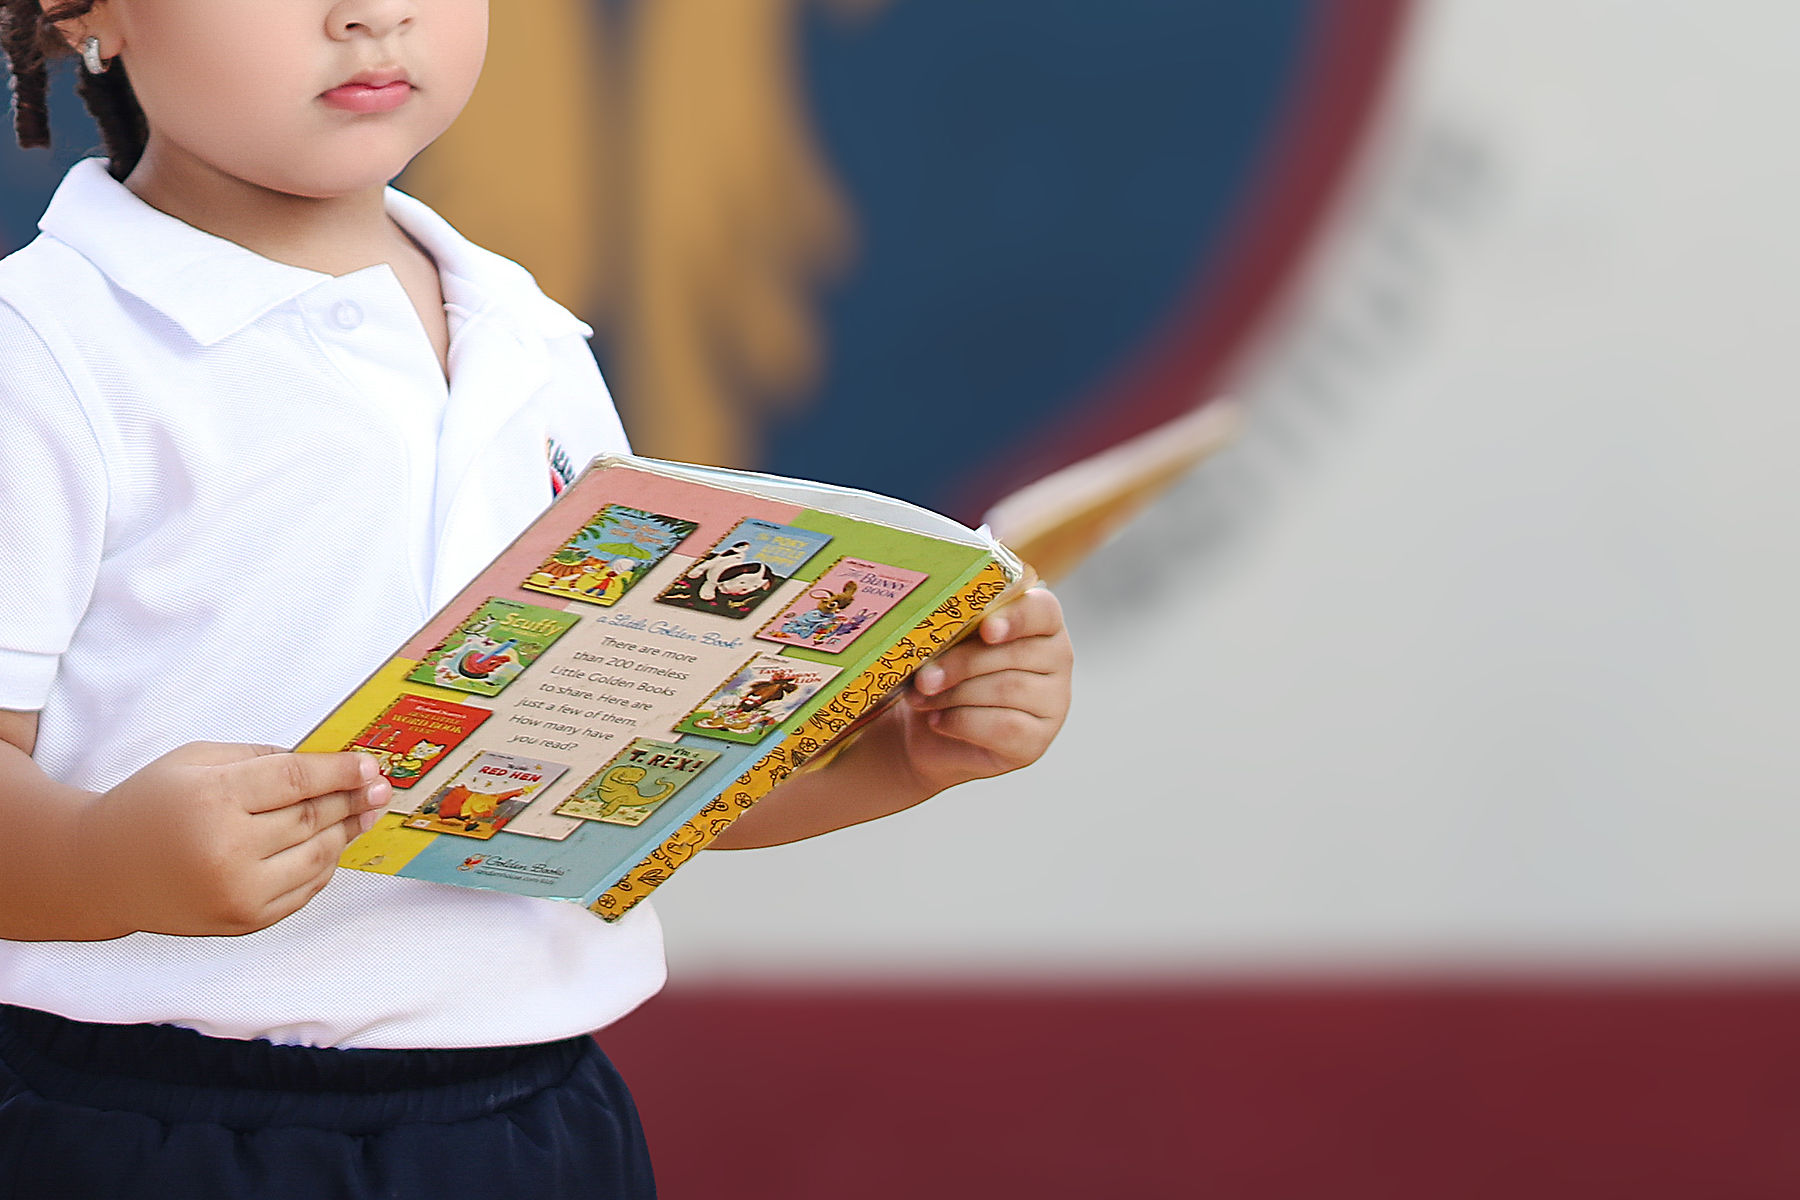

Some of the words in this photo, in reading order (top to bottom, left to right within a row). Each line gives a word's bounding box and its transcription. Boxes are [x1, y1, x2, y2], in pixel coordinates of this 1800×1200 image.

[499, 612, 564, 638] Scuffy
[648, 620, 698, 642] Golden
[600, 635, 636, 651] There
[638, 644, 660, 657] are
[661, 650, 698, 664] more
[573, 650, 604, 665] than
[604, 656, 635, 670] 200
[635, 663, 690, 681] timeless
[550, 665, 586, 680] Little
[588, 672, 636, 689] Golden
[637, 680, 678, 698] Books
[539, 682, 556, 693] to
[557, 686, 594, 701] share.
[596, 694, 631, 708] Here
[631, 701, 654, 712] are
[513, 696, 543, 710] just
[545, 702, 556, 711] a
[557, 702, 583, 717] few
[584, 709, 603, 720] of
[600, 712, 638, 728] them.
[508, 714, 543, 728] How
[543, 720, 581, 737] many
[581, 727, 615, 742] have
[506, 734, 539, 745] you
[539, 737, 579, 751] read?
[479, 765, 508, 777] RED
[508, 770, 543, 782] HEN
[629, 748, 649, 763] T.
[646, 752, 704, 773] REX!
